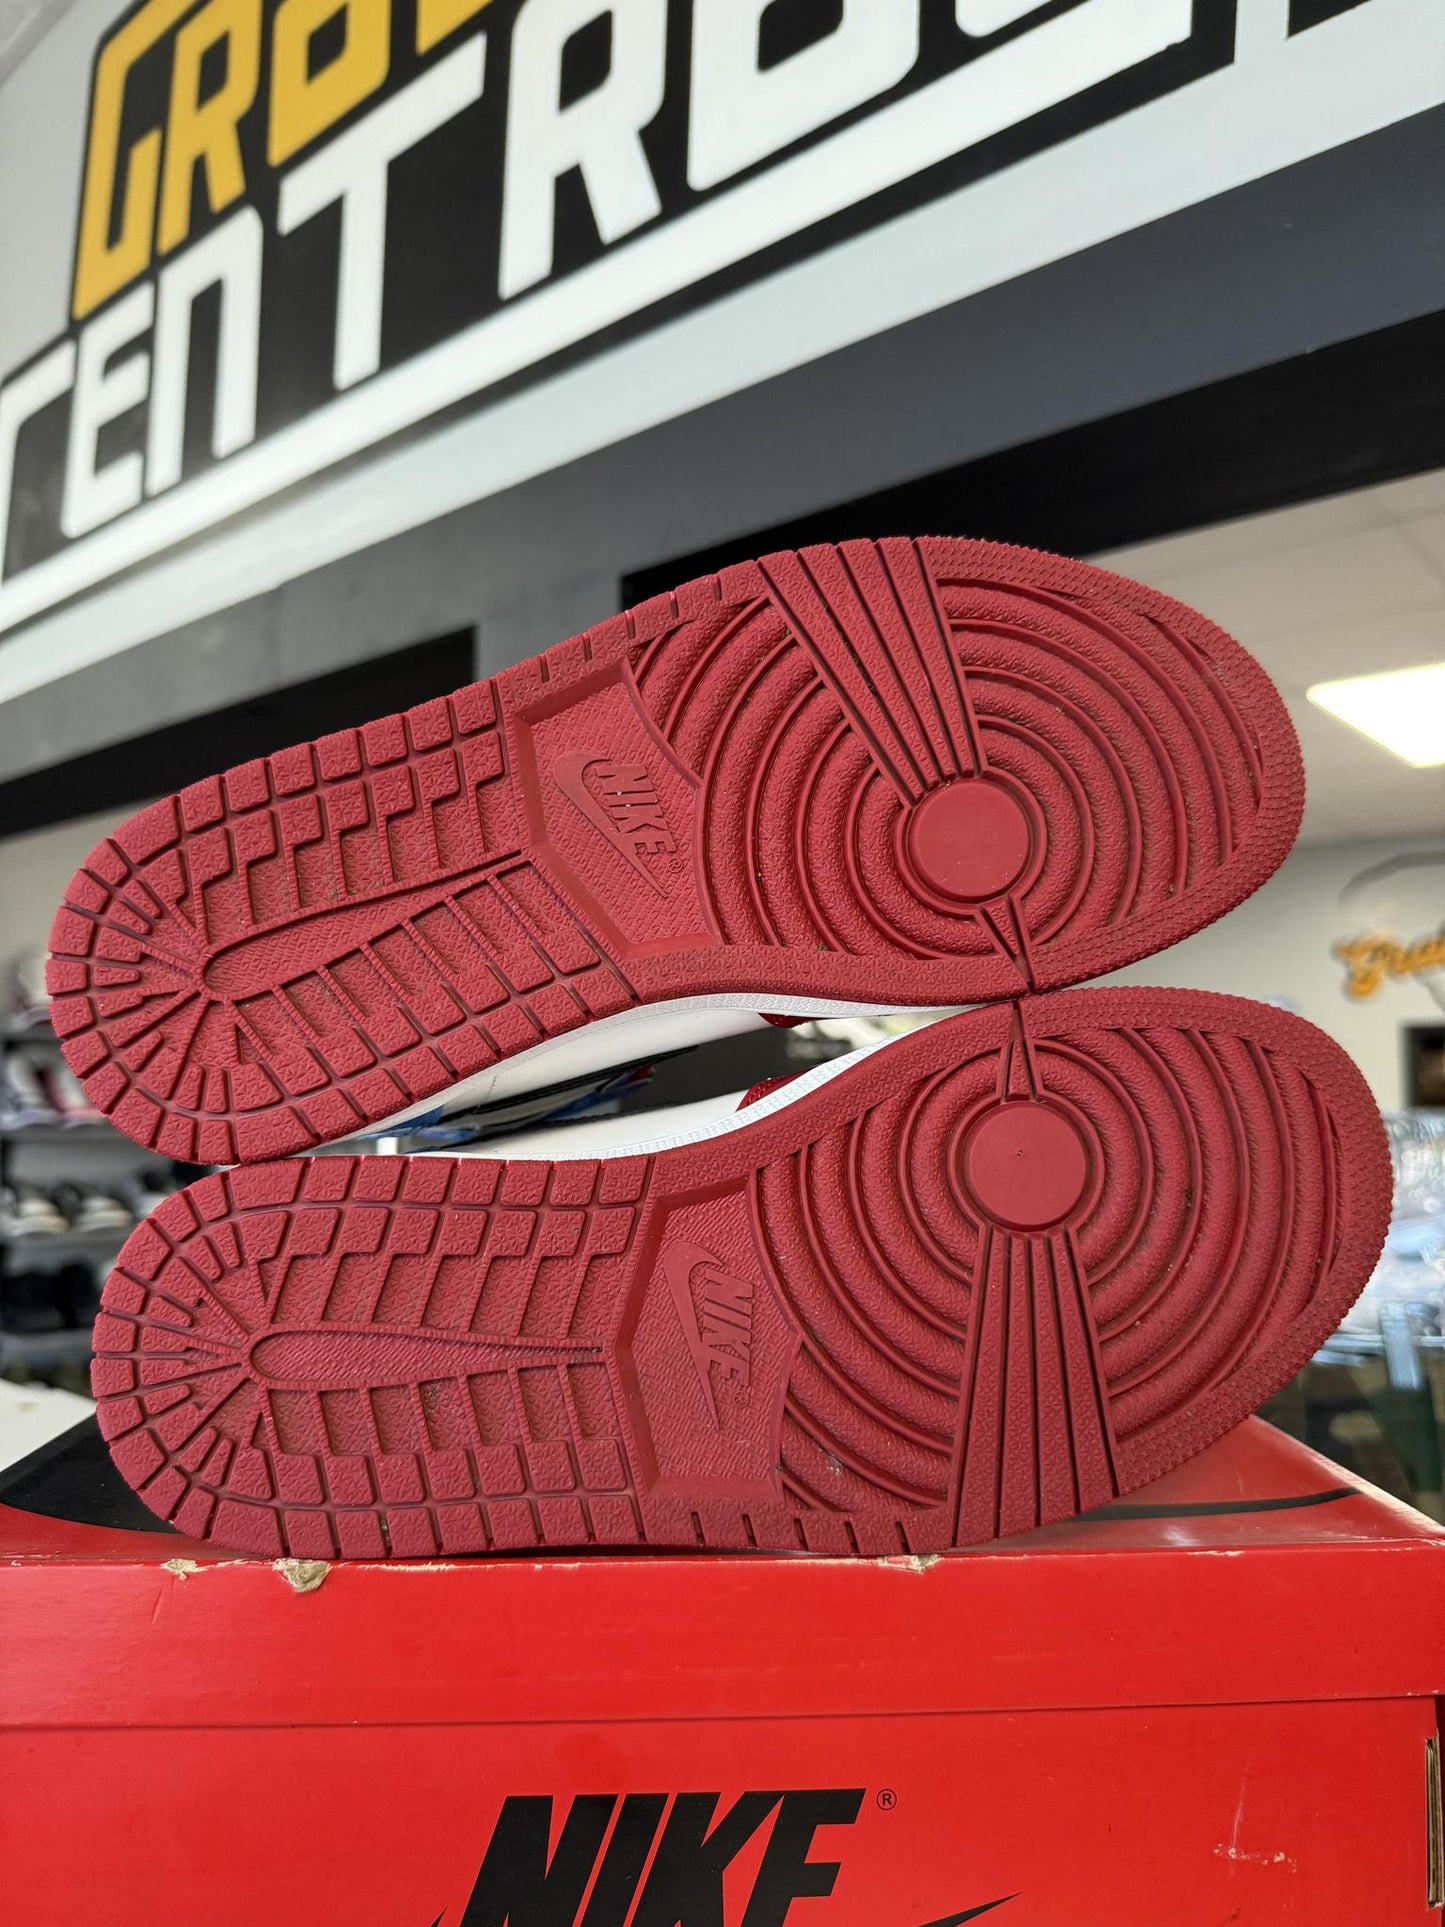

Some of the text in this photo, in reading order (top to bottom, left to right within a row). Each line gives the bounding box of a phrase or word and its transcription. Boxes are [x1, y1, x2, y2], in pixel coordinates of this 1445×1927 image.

[595, 763, 677, 854] NIKE
[702, 1268, 754, 1388] NIKE
[459, 1788, 866, 1927] NIKE
